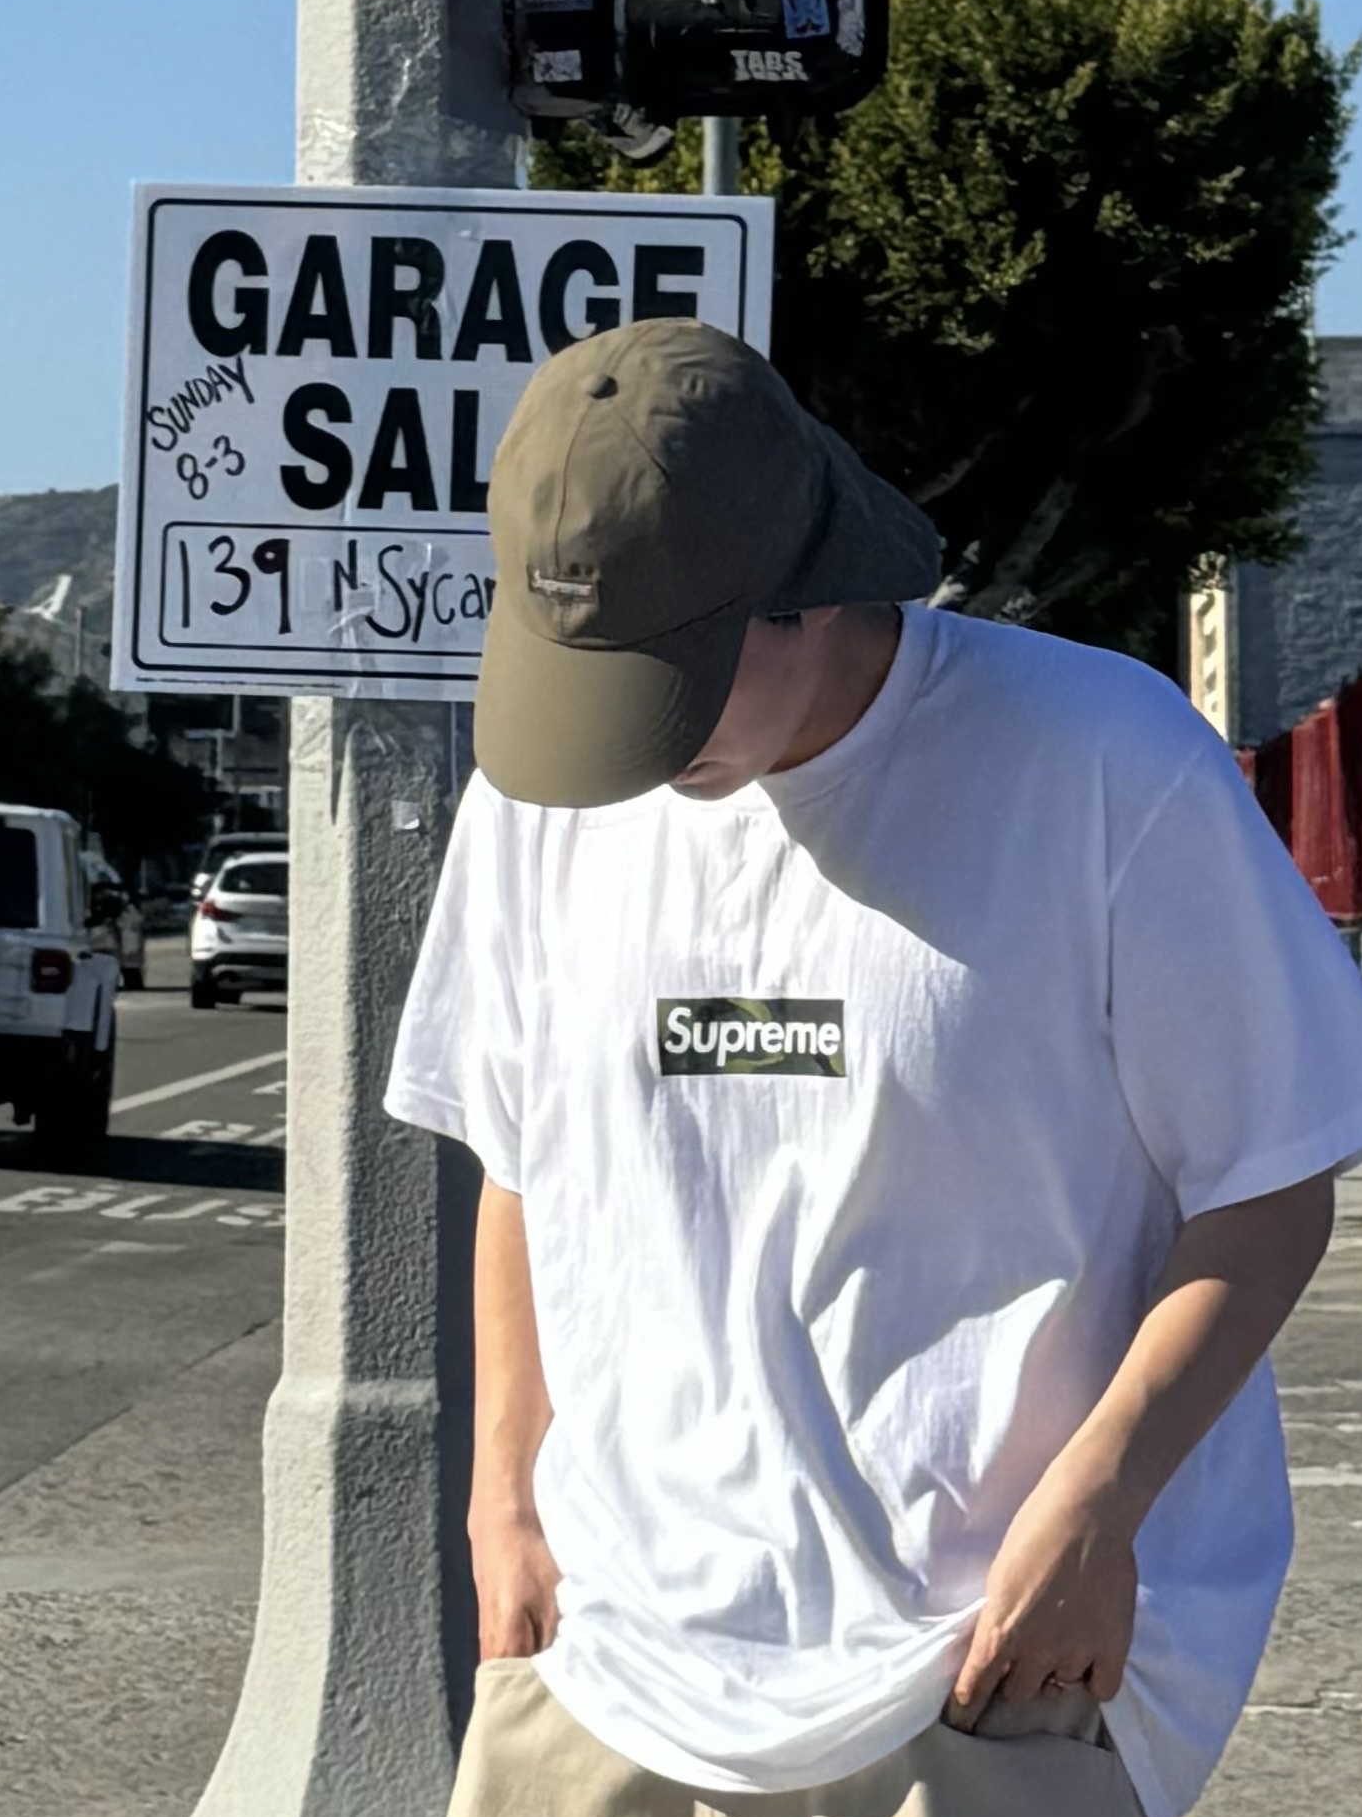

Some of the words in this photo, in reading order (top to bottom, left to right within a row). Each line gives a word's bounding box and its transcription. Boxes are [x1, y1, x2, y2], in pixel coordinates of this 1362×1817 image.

[187, 229, 705, 363] GARAGE
[146, 355, 256, 452] SUNDAY
[280, 382, 494, 513] SAL
[176, 435, 246, 500] 8-3
[179, 534, 292, 634] 139
[664, 1006, 841, 1067] Supreme
